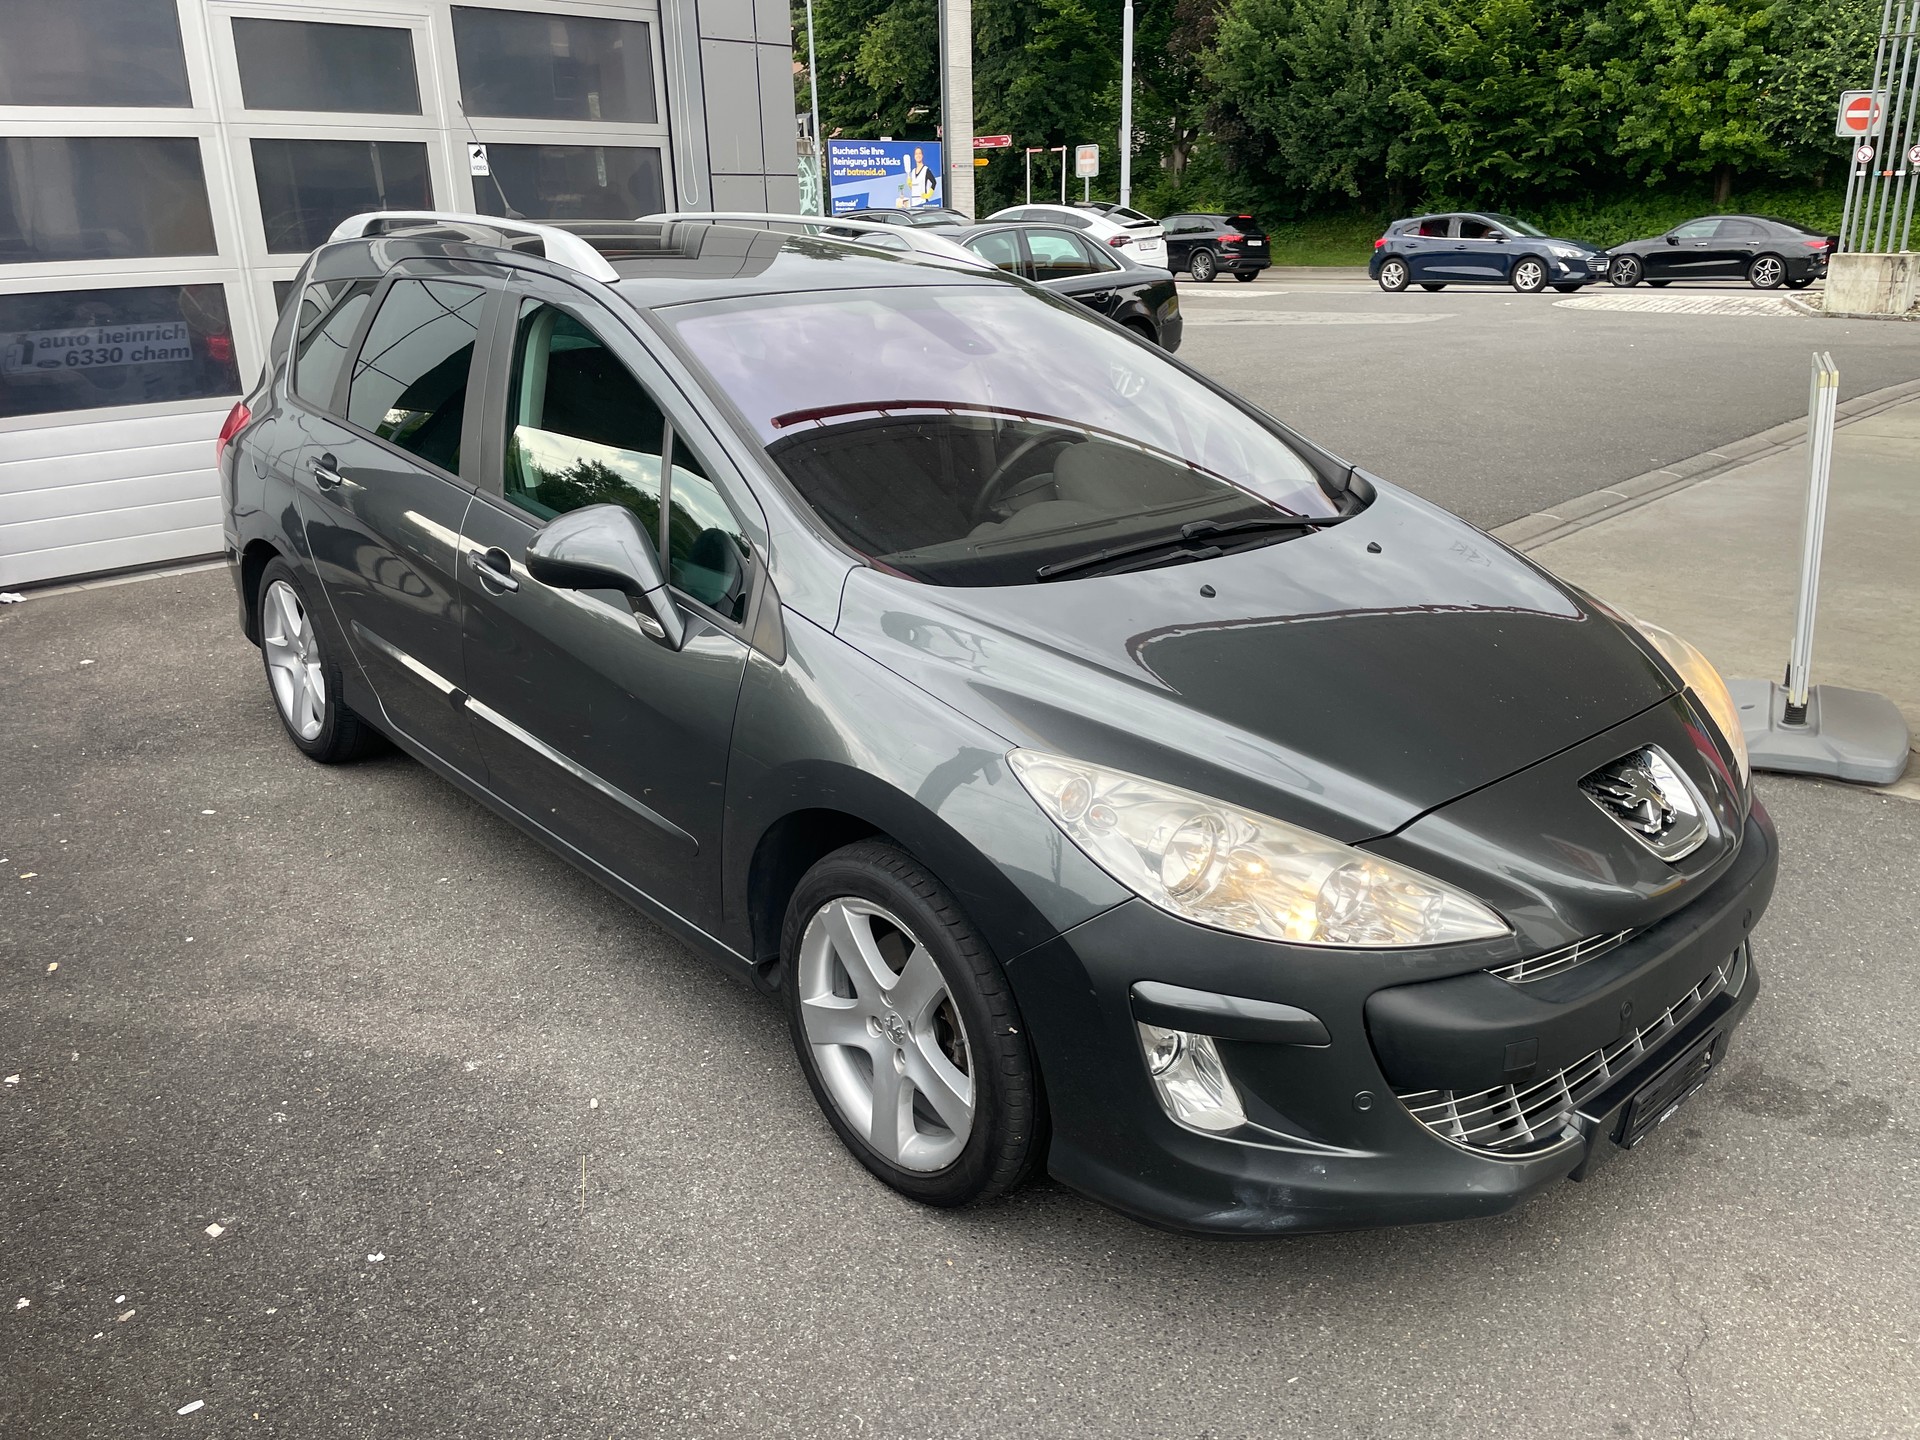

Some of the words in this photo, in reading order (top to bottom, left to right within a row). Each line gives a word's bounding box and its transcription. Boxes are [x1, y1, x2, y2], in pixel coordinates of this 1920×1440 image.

[832, 146, 858, 155] Buchen
[859, 147, 870, 155] Sie
[871, 147, 884, 155] Ihre
[832, 157, 867, 167] Reinigung
[868, 157, 875, 165] in
[881, 157, 900, 165] Klicks
[847, 168, 886, 176] batmaid.ch
[39, 335, 90, 349] auto
[98, 324, 186, 345] heinrich
[65, 347, 123, 367] 6330
[131, 345, 190, 362] cham
